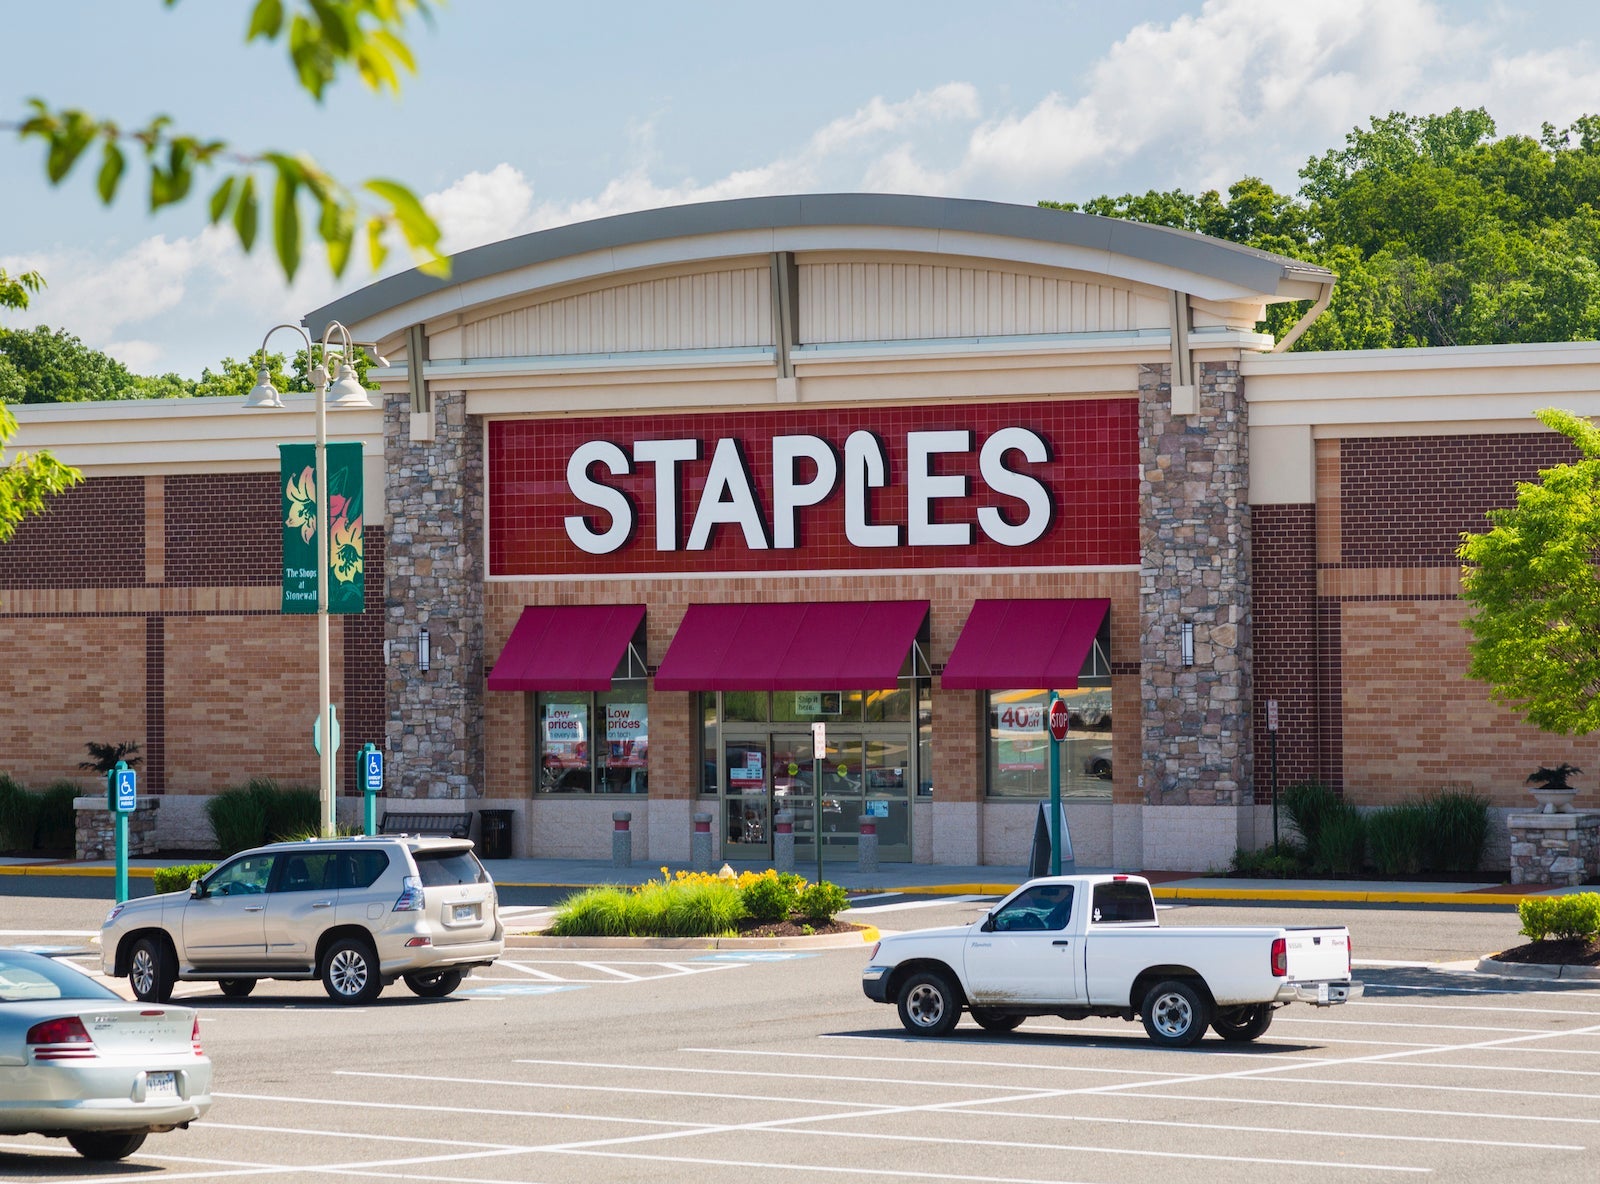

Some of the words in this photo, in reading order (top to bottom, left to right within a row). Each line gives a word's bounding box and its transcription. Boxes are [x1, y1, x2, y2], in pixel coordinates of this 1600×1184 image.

[564, 426, 1053, 555] STAPLES
[286, 568, 299, 578] The
[299, 568, 317, 579] Shops
[298, 580, 305, 589] at
[285, 590, 317, 600] Stonewall
[547, 708, 570, 719] Low
[607, 708, 630, 718] Low
[547, 719, 580, 731] prices
[607, 719, 640, 731] prices
[1051, 713, 1068, 728] STOP
